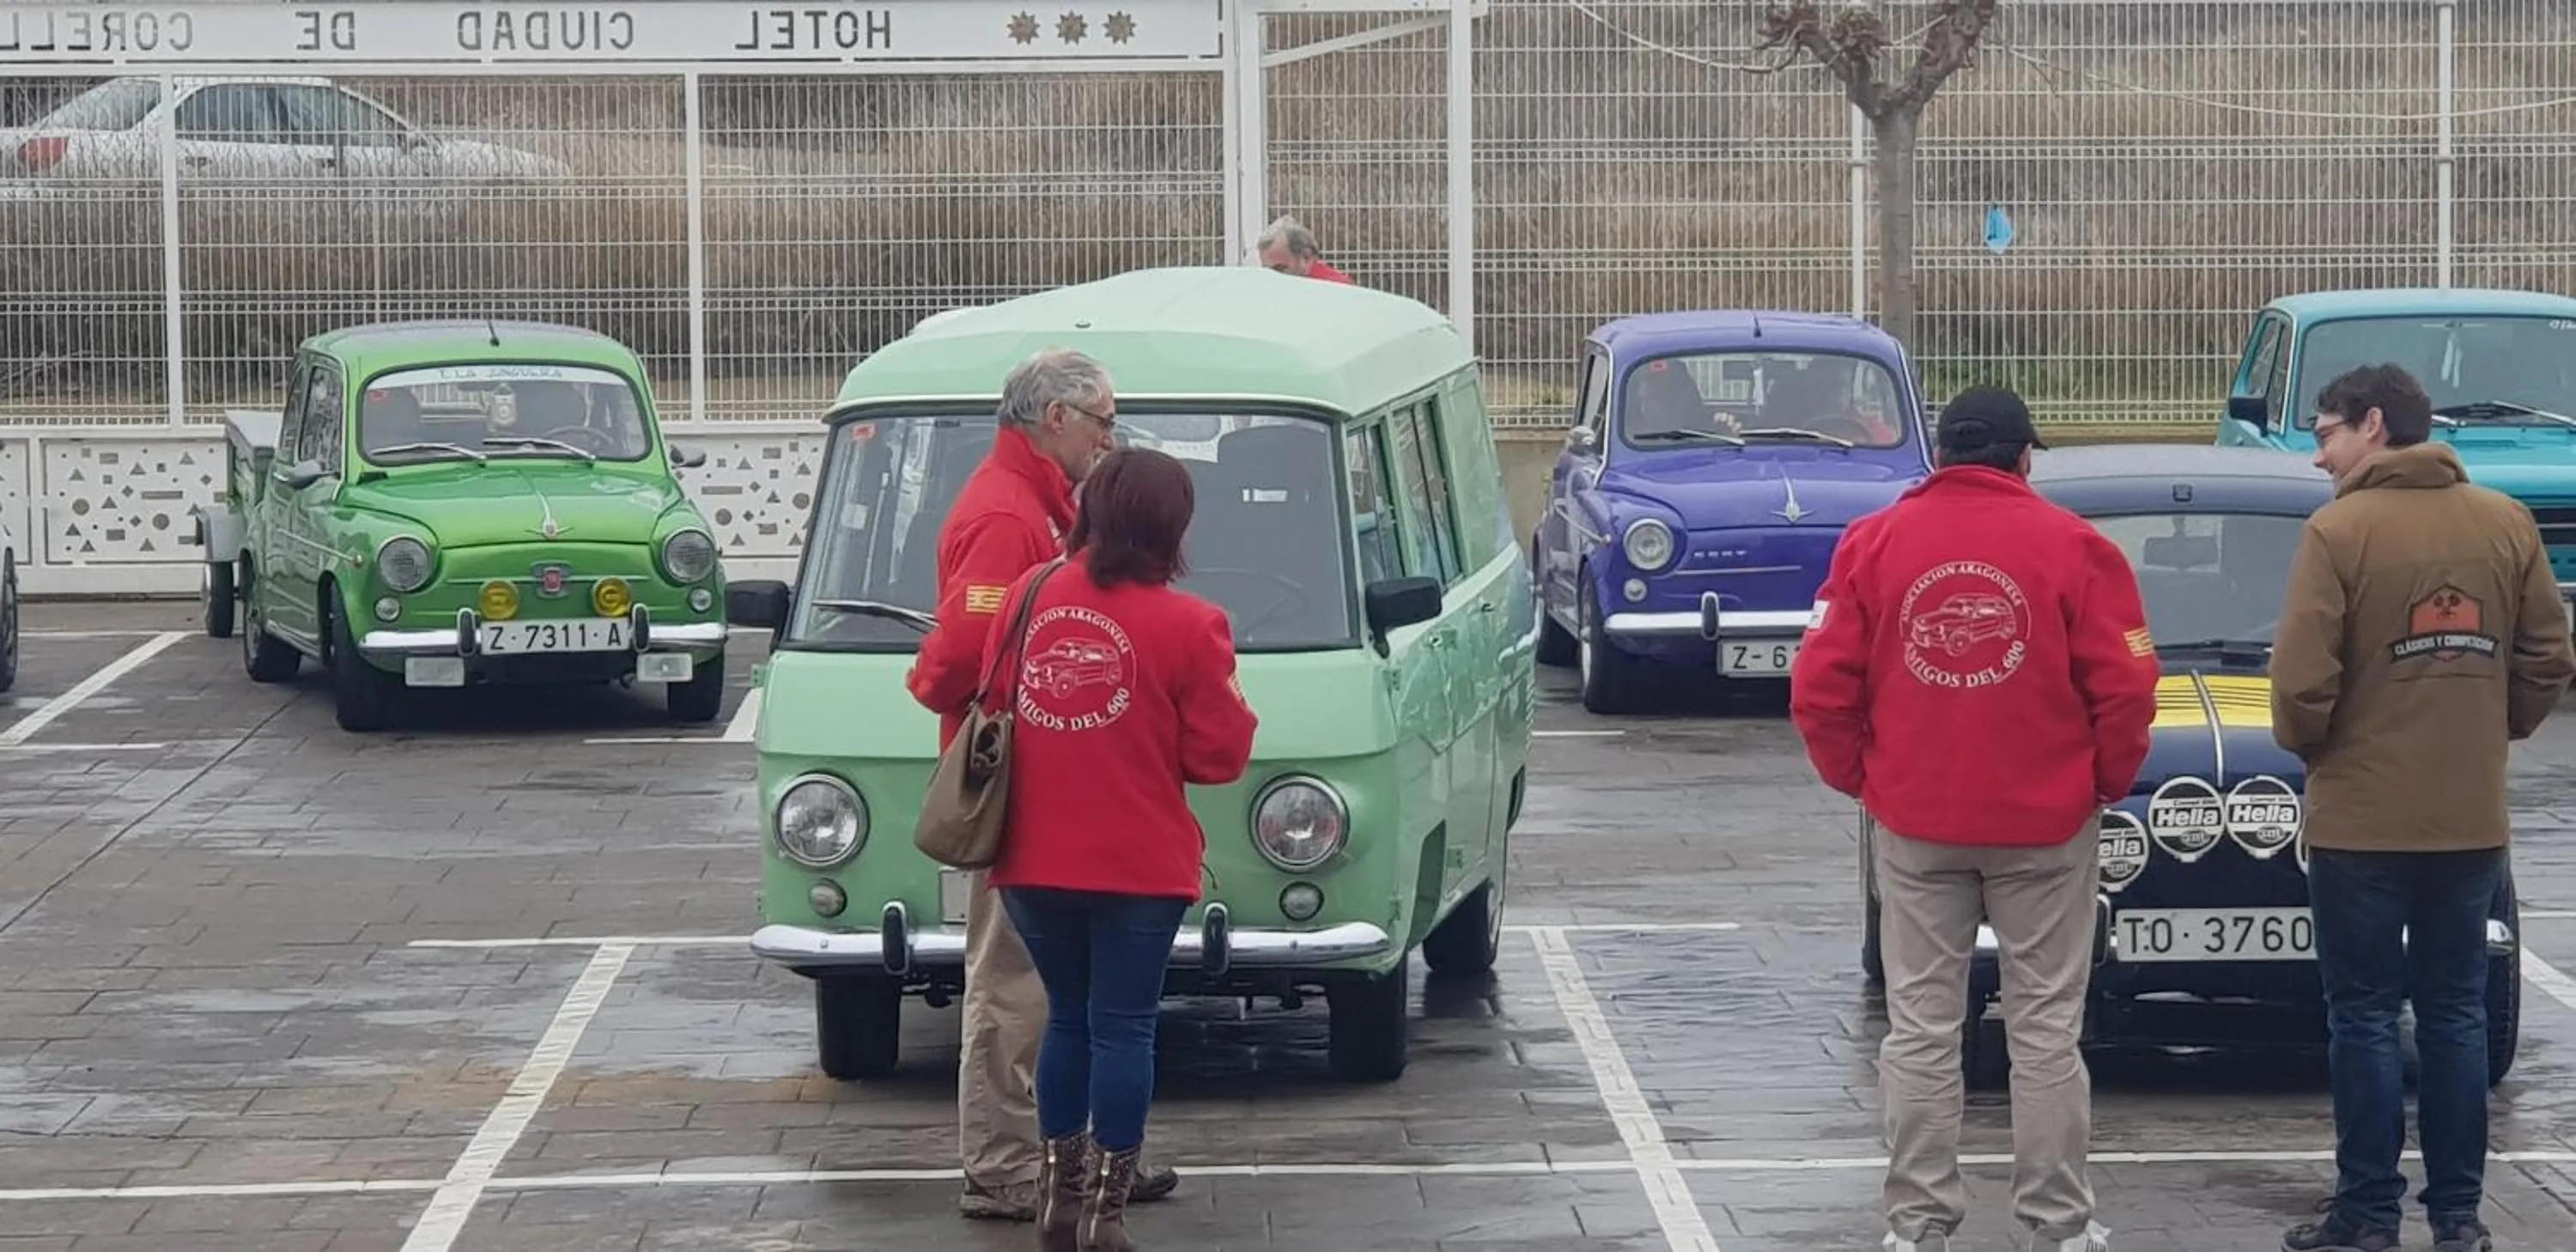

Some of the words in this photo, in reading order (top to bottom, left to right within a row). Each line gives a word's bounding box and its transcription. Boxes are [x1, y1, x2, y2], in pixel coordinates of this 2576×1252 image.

[1958, 563, 2023, 606] ARAGONESA
[1067, 608, 1130, 655] ARAGONESA
[1905, 641, 1960, 688] AMIGOS
[1965, 666, 2002, 688] DEL
[2002, 640, 2026, 669] 600
[1071, 711, 1106, 731] DEL
[1106, 687, 1130, 715] 600
[2156, 807, 2218, 827] Hella
[2233, 804, 2295, 823] Hella
[2099, 838, 2141, 857] ella
